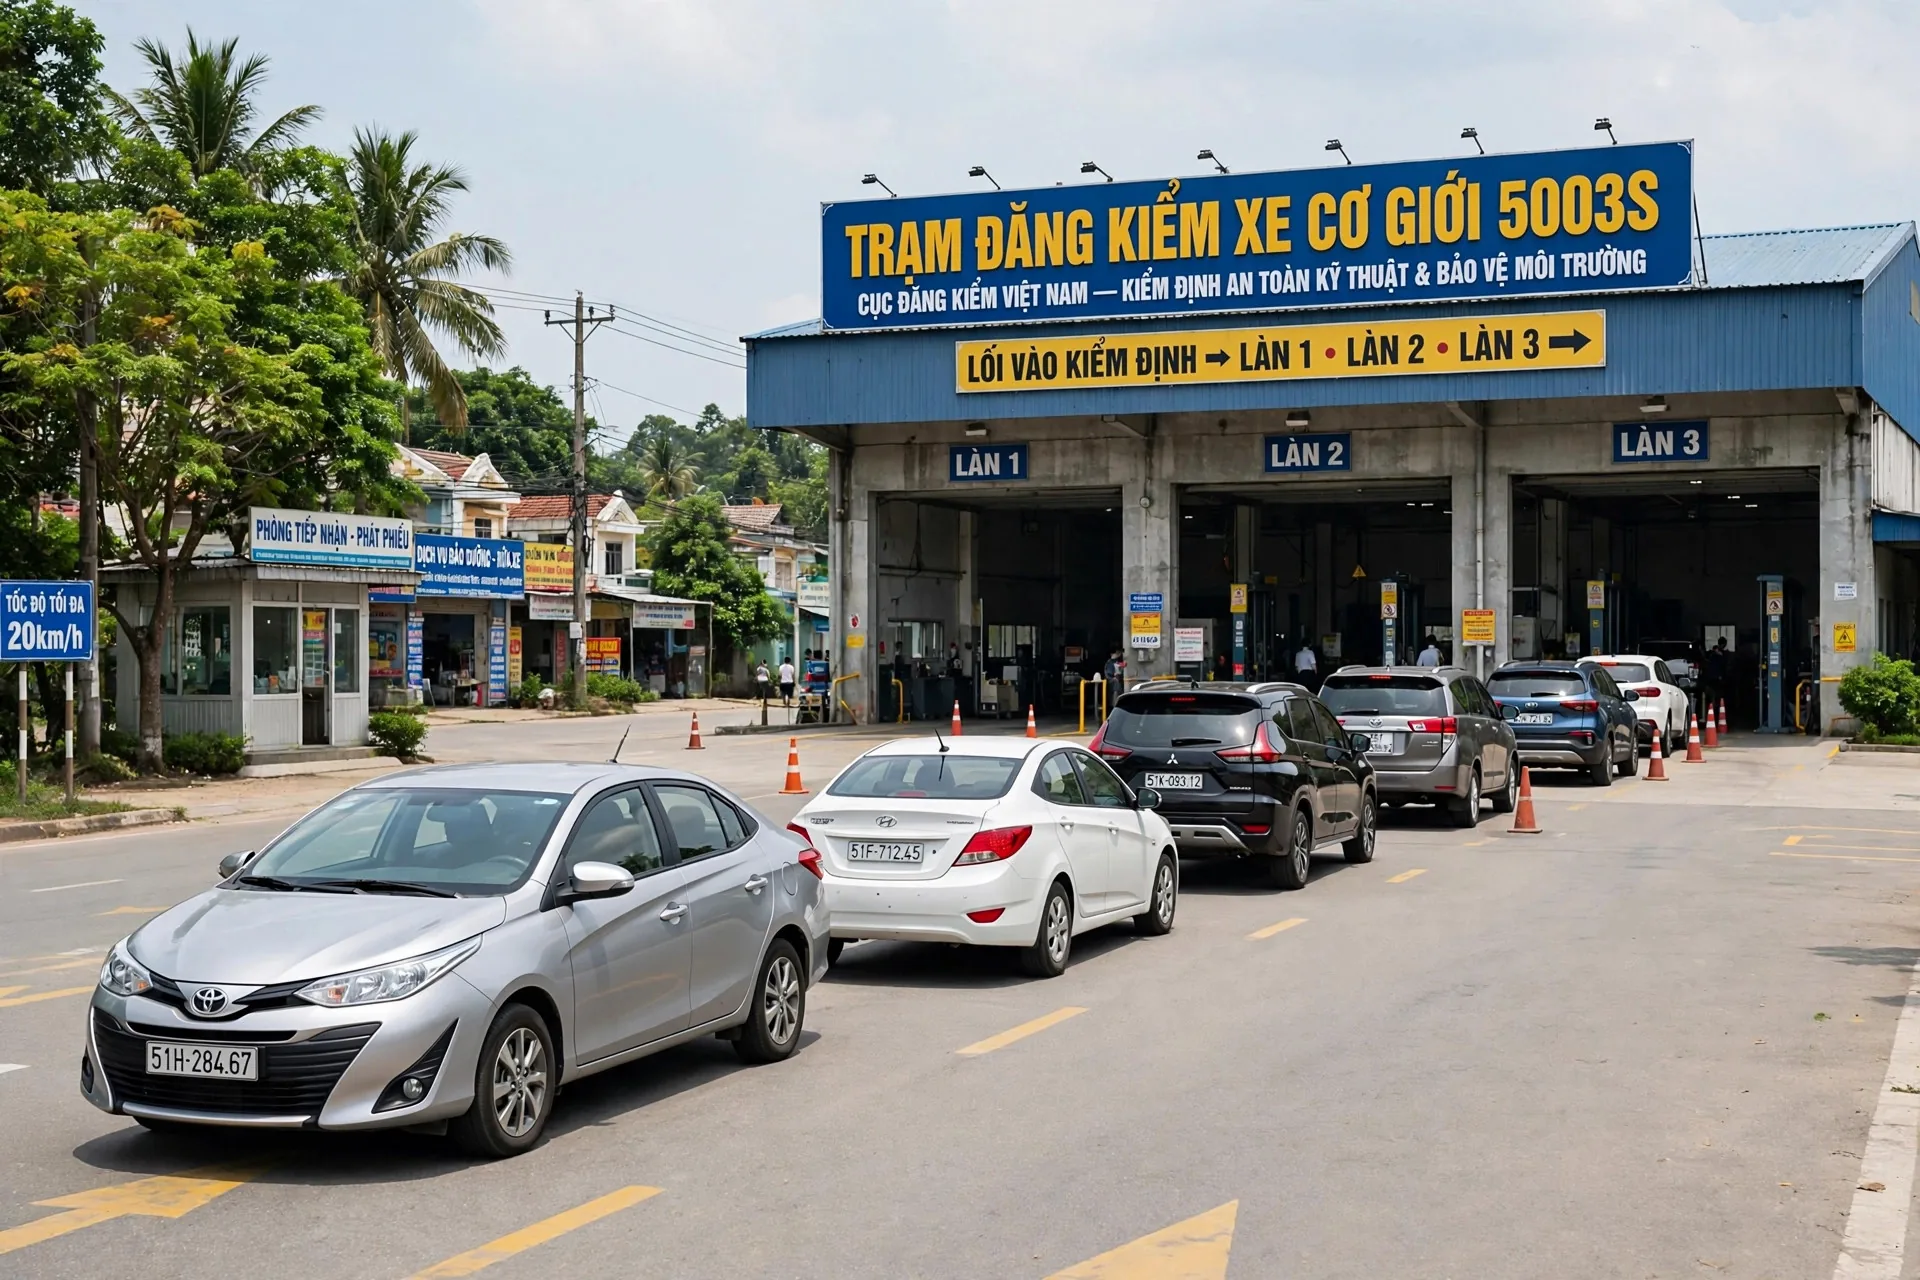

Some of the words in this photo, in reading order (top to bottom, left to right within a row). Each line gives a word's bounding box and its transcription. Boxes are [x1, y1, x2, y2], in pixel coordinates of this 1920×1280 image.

[845, 217, 962, 286] TRẠM
[975, 200, 1093, 271] ĐĂNG
[1108, 178, 1220, 262] KIỂM
[1234, 195, 1291, 256] XE
[1308, 184, 1371, 251] CƠ
[1385, 169, 1480, 245] GIỚI
[1498, 169, 1660, 240] 5003S
[857, 291, 892, 321] CỤC
[897, 285, 947, 314] ĐĂNG
[952, 276, 998, 311] KIỂM
[1003, 279, 1041, 313] VIỆT
[1046, 281, 1088, 306] NAM
[1122, 267, 1169, 303] KIỂM
[1174, 273, 1221, 305] ĐỊNH
[1226, 271, 1254, 296] AN
[1259, 262, 1310, 294] TOÀN
[1316, 260, 1340, 292] KỸ
[1346, 257, 1410, 294] THUẬT
[1414, 262, 1431, 285] &
[1437, 252, 1477, 284] BẢO
[1483, 251, 1509, 288] VỆ
[1515, 249, 1556, 281] MÔI
[1561, 243, 1646, 276] TRƯỜNG
[967, 343, 1004, 384] LỐI
[1011, 345, 1058, 381] VÀO
[1066, 336, 1128, 378] KIỂM
[1136, 344, 1197, 382] ĐỊNH
[1239, 334, 1291, 372] LÀN
[1298, 340, 1312, 369] 1
[1347, 329, 1400, 367] LÀN
[1408, 333, 1424, 364] 2
[1459, 323, 1513, 362] LÀN
[1522, 328, 1540, 360] 3
[1271, 436, 1320, 468] LÀN
[1328, 441, 1347, 466] 2
[1621, 425, 1674, 458] LÀN
[1682, 430, 1701, 456] 3
[955, 447, 1001, 477] LÀN
[1008, 452, 1020, 475] 1
[256, 514, 292, 543] PHÒNG
[294, 515, 317, 544] TIẾP
[356, 522, 380, 548] PHÁT
[382, 522, 409, 550] PHIẾU
[6, 587, 28, 613] TỐC
[30, 591, 46, 617] ĐỘ
[49, 588, 67, 613] TỐI
[69, 595, 85, 613] ĐA
[7, 620, 83, 653] 20km/h
[1146, 774, 1201, 788] 51K-093.12
[851, 843, 920, 861] 51F-712.45
[151, 1046, 252, 1076] 51H-284.67
